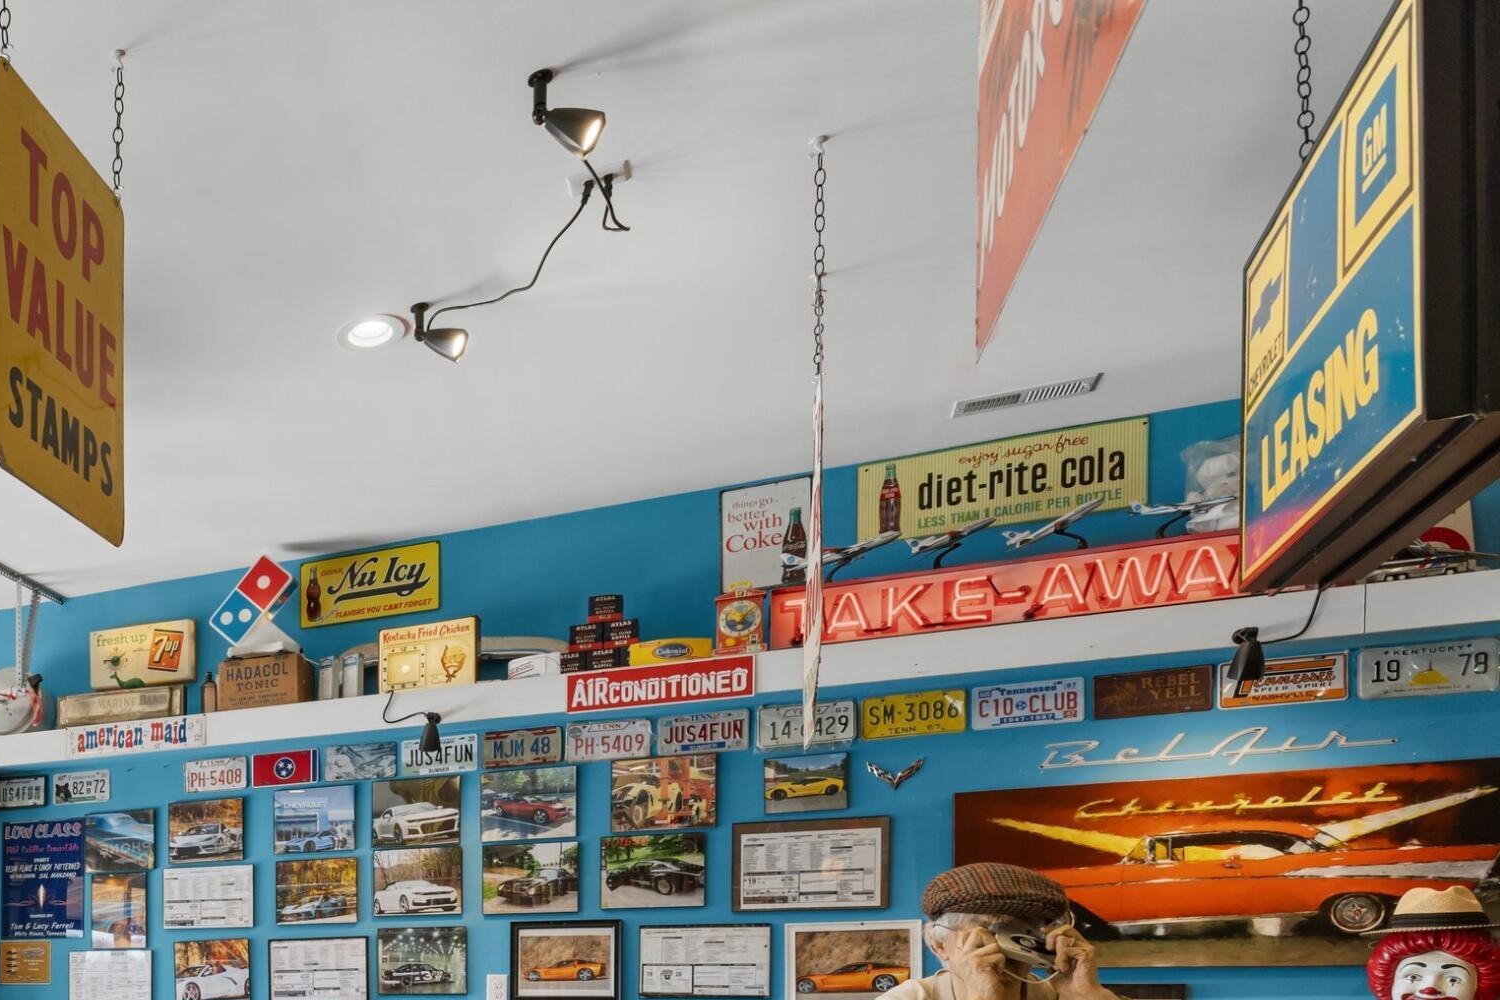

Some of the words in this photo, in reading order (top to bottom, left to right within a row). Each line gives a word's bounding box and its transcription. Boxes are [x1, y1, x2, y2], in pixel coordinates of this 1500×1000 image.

[1361, 103, 1387, 176] GM
[20, 127, 105, 282] TOP
[2, 223, 116, 410] VALUE
[1248, 330, 1284, 398] CHEVROLET
[1261, 309, 1379, 513] LEASING
[8, 366, 113, 497] STAMPS
[959, 450, 1000, 468] enjoy
[1002, 443, 1051, 459] sugar
[1049, 434, 1090, 453] free
[918, 461, 1048, 510] diet-rite
[1060, 448, 1126, 489] cola
[759, 496, 774, 507] go
[917, 516, 946, 529] LESS
[951, 510, 980, 525] THAN
[983, 507, 991, 519] 1
[994, 502, 1043, 519] CALORIE
[1047, 496, 1071, 510] PER
[1076, 488, 1123, 507] BOTTLE
[727, 508, 767, 524] better
[743, 514, 783, 532] with
[725, 531, 783, 553] Coke
[327, 557, 378, 595] Nu
[383, 556, 431, 590] Icy
[781, 545, 1240, 646] TAKE-AWA
[334, 607, 366, 619] FLAVORS
[366, 604, 382, 614] YOU
[403, 598, 432, 609] FORGET
[382, 631, 416, 645] Kentucky
[418, 625, 438, 639] Fried
[438, 623, 471, 637] Chicken
[610, 620, 632, 628] ATLAS
[95, 634, 129, 648] fresh
[131, 633, 148, 646] up
[1393, 644, 1465, 656] KENTUCKY
[655, 647, 688, 657] Colonial
[225, 660, 289, 682] HADACOL
[1141, 672, 1199, 689] REBEL
[1371, 659, 1400, 683] 19
[236, 678, 280, 692] TONIC
[998, 685, 1057, 697] Tennessee
[1151, 686, 1202, 701] YELL
[1253, 685, 1289, 693] SPEED
[979, 697, 1013, 718] C10
[1029, 691, 1079, 713] CLUB
[1251, 691, 1311, 701] NASHVILLE
[690, 712, 712, 722] TENN
[834, 705, 849, 713] 62
[868, 699, 958, 726] SM-3086
[77, 725, 144, 753] american
[150, 718, 188, 743] maid
[595, 722, 622, 731] TENN
[663, 719, 746, 745] JUS4FUN
[887, 725, 916, 736] TENN
[493, 740, 525, 759] MJM
[530, 736, 550, 754] 48
[574, 732, 645, 755] PH-5409
[405, 743, 474, 769] JUS4FUN
[72, 780, 84, 795] 82
[93, 779, 106, 794] 72
[190, 768, 243, 788] PH-5408
[283, 800, 327, 809] CHEVROLET
[1074, 782, 1399, 819] Chevrolet
[4, 825, 34, 840] LOW
[34, 822, 82, 839] CLASS
[32, 922, 49, 931] Lucy
